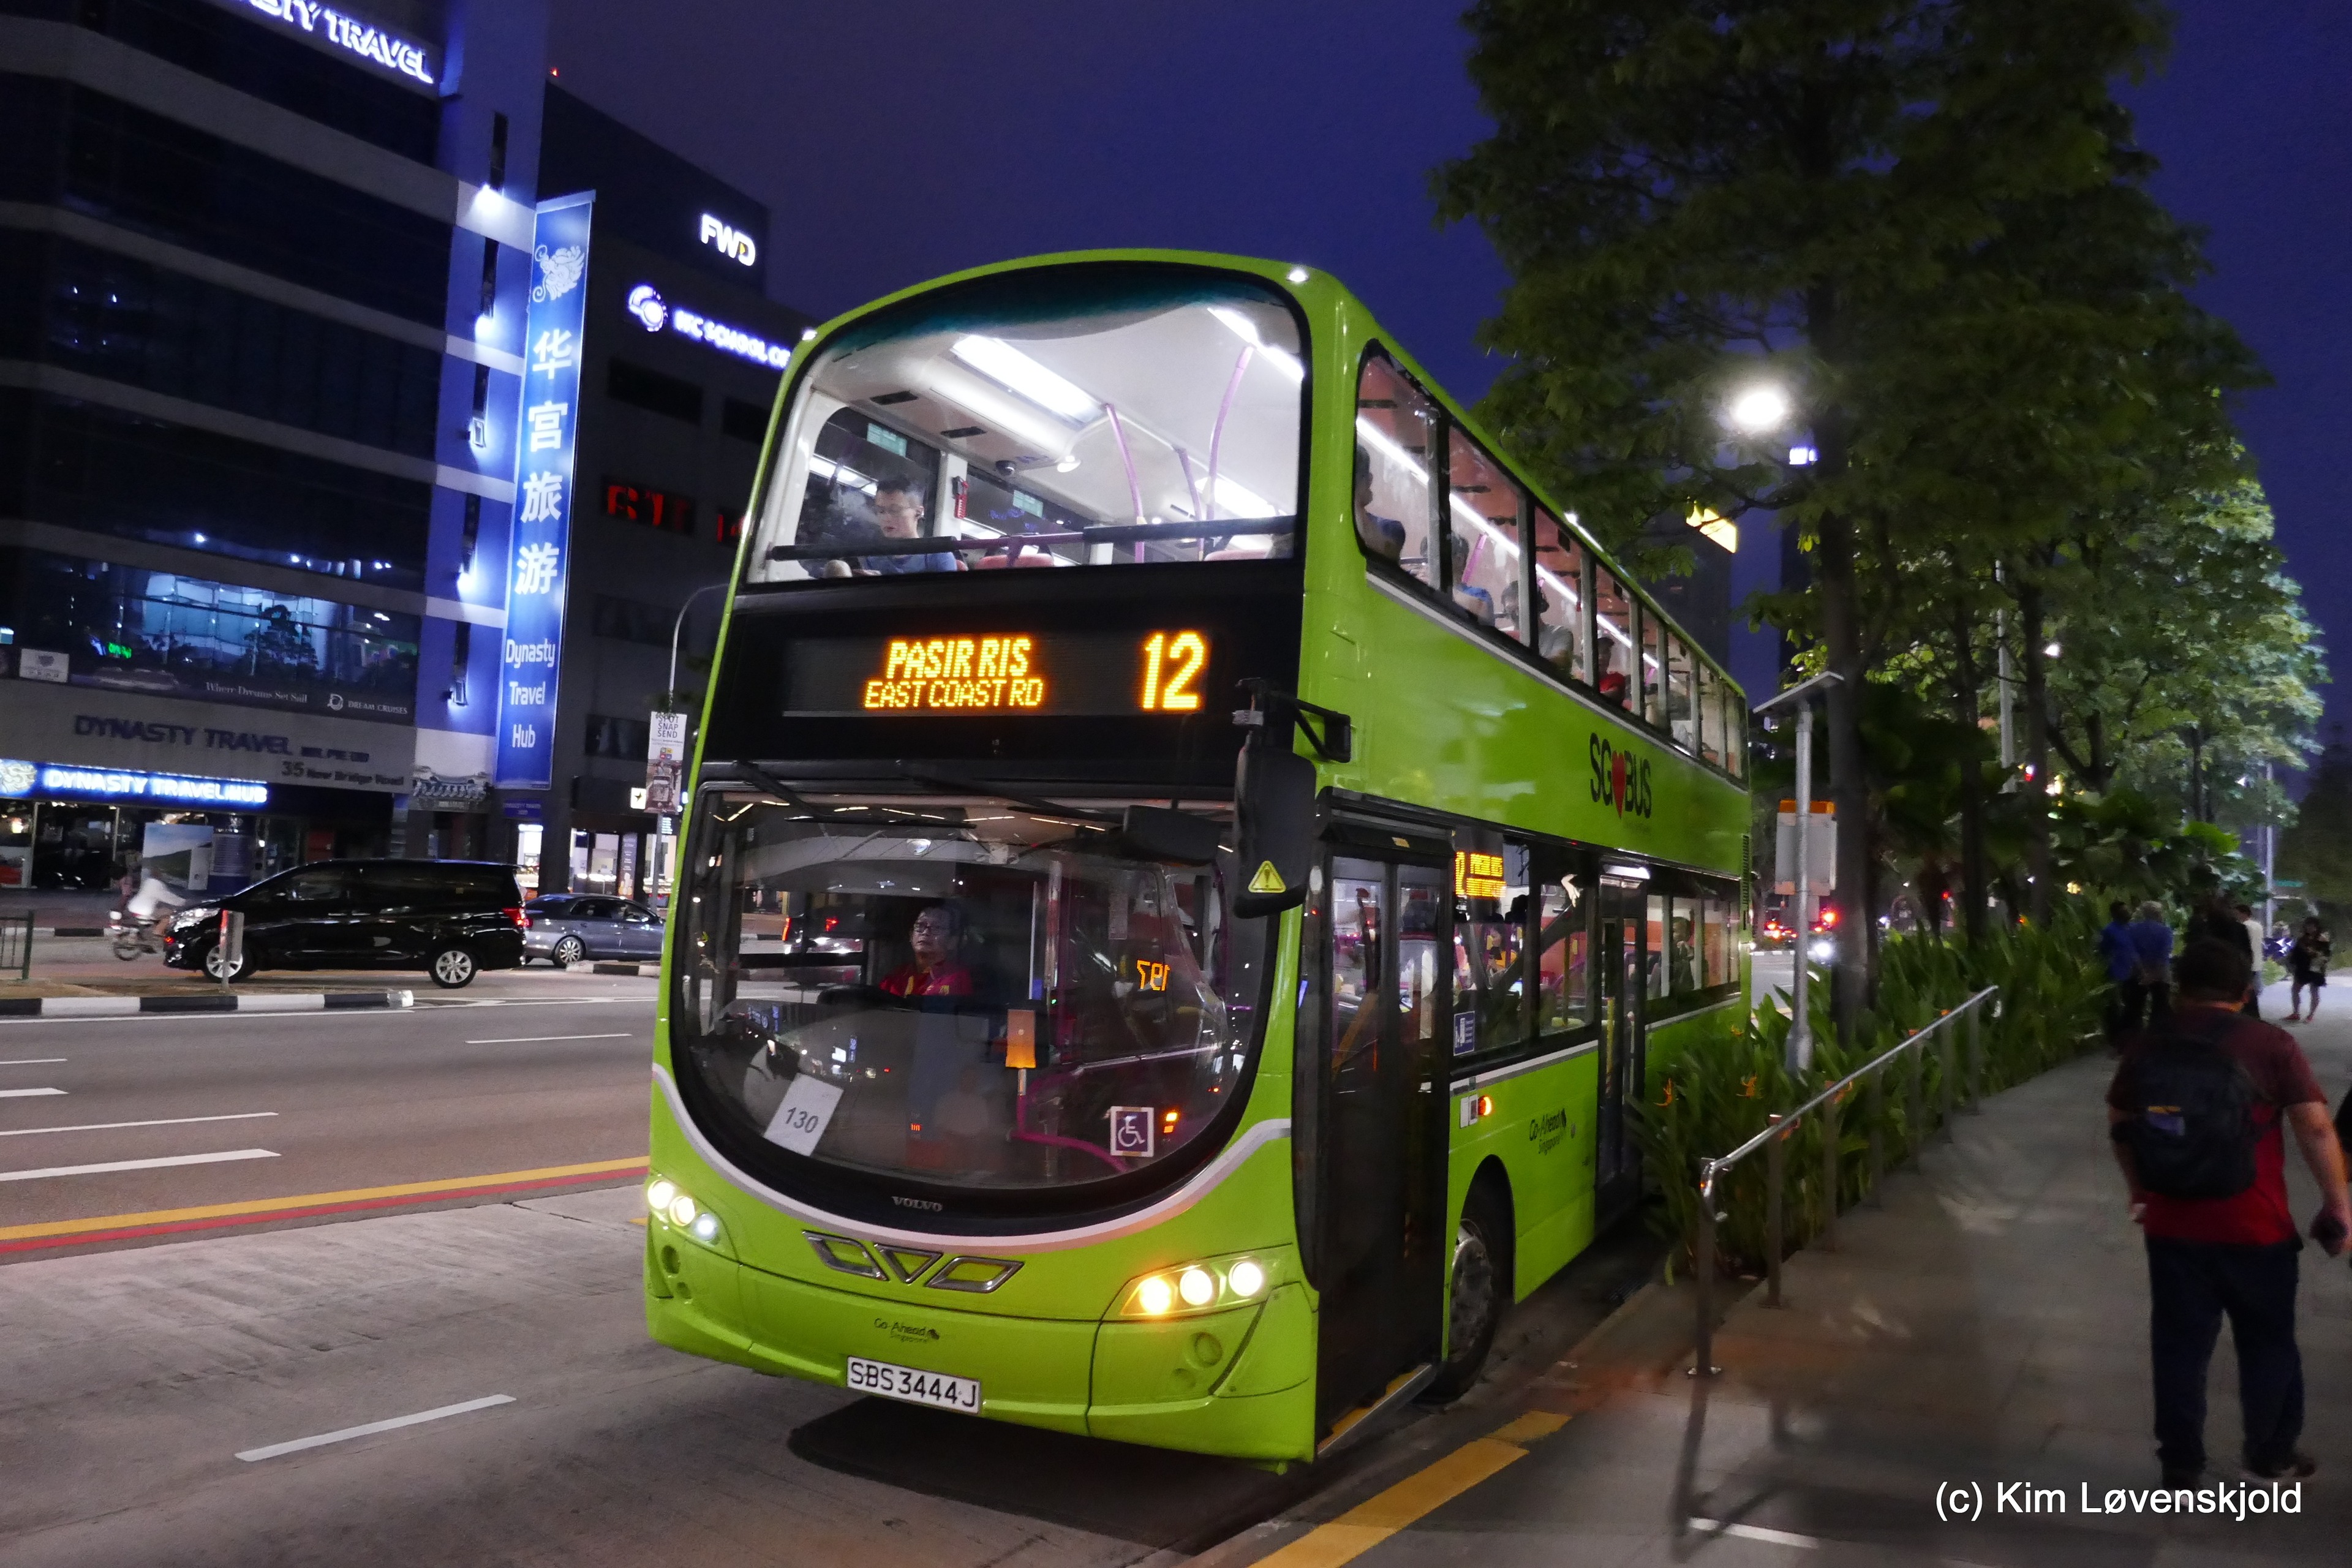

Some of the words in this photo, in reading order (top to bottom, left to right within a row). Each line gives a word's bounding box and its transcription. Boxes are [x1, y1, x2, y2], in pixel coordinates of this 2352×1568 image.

[323, 9, 434, 84] TRAVEL
[701, 213, 756, 266] FWD
[704, 322, 768, 361] SCHOOL
[514, 329, 573, 595] 华宫旅游
[505, 638, 556, 668] Dynasty
[886, 640, 974, 679] PASIR
[979, 639, 1032, 677] RIS
[1142, 633, 1205, 710] 12
[348, 699, 375, 710] DREAM
[377, 703, 408, 715] CRUISES
[510, 681, 546, 705] Travel
[864, 681, 927, 708] EAST
[928, 680, 1008, 707] COAST
[1009, 679, 1044, 707] RD
[75, 714, 198, 745] DYNASTY
[204, 728, 293, 756] TRAVEL
[512, 724, 535, 748] Hub
[282, 761, 304, 777] 35
[47, 770, 149, 794] DYNASTY
[153, 778, 225, 800] TRAVEL
[785, 1107, 819, 1133] 130
[891, 1196, 943, 1212] VOLVO
